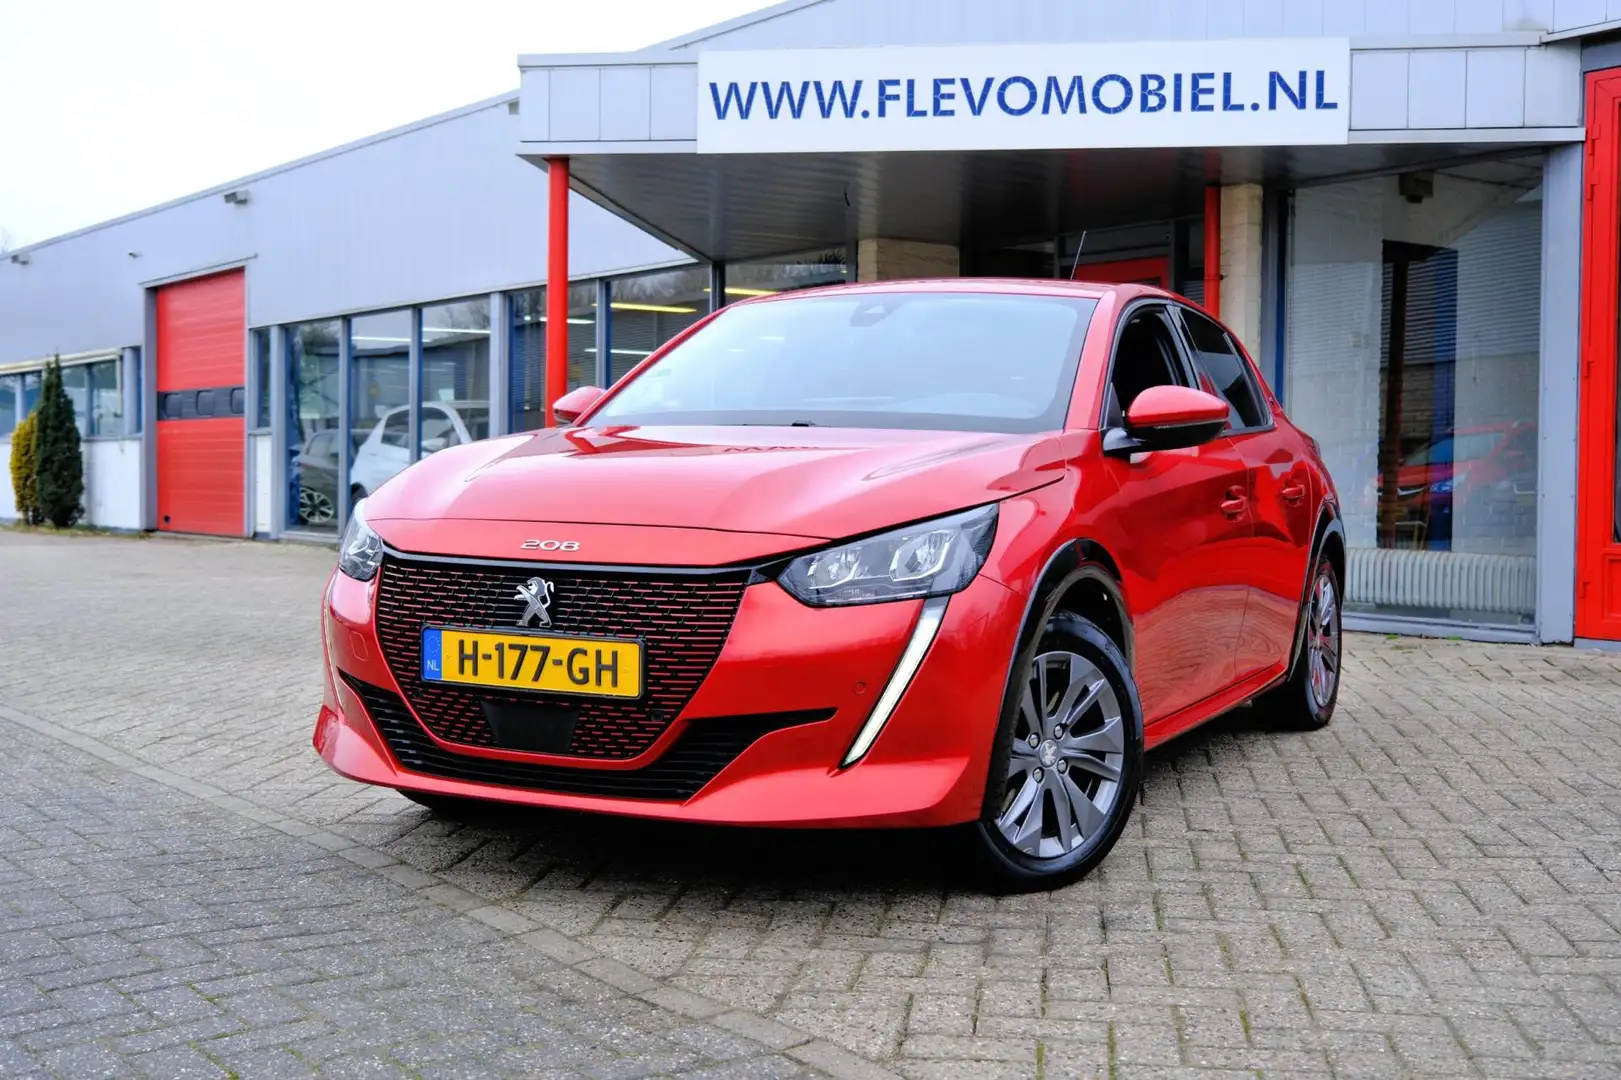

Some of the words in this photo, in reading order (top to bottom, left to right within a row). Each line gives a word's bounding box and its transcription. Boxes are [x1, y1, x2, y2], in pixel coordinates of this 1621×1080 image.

[709, 69, 1338, 120] WWW.FLEVOMOBIEL.NL
[520, 539, 580, 551] 208
[426, 659, 439, 671] NL
[458, 639, 618, 687] H-177-GH
